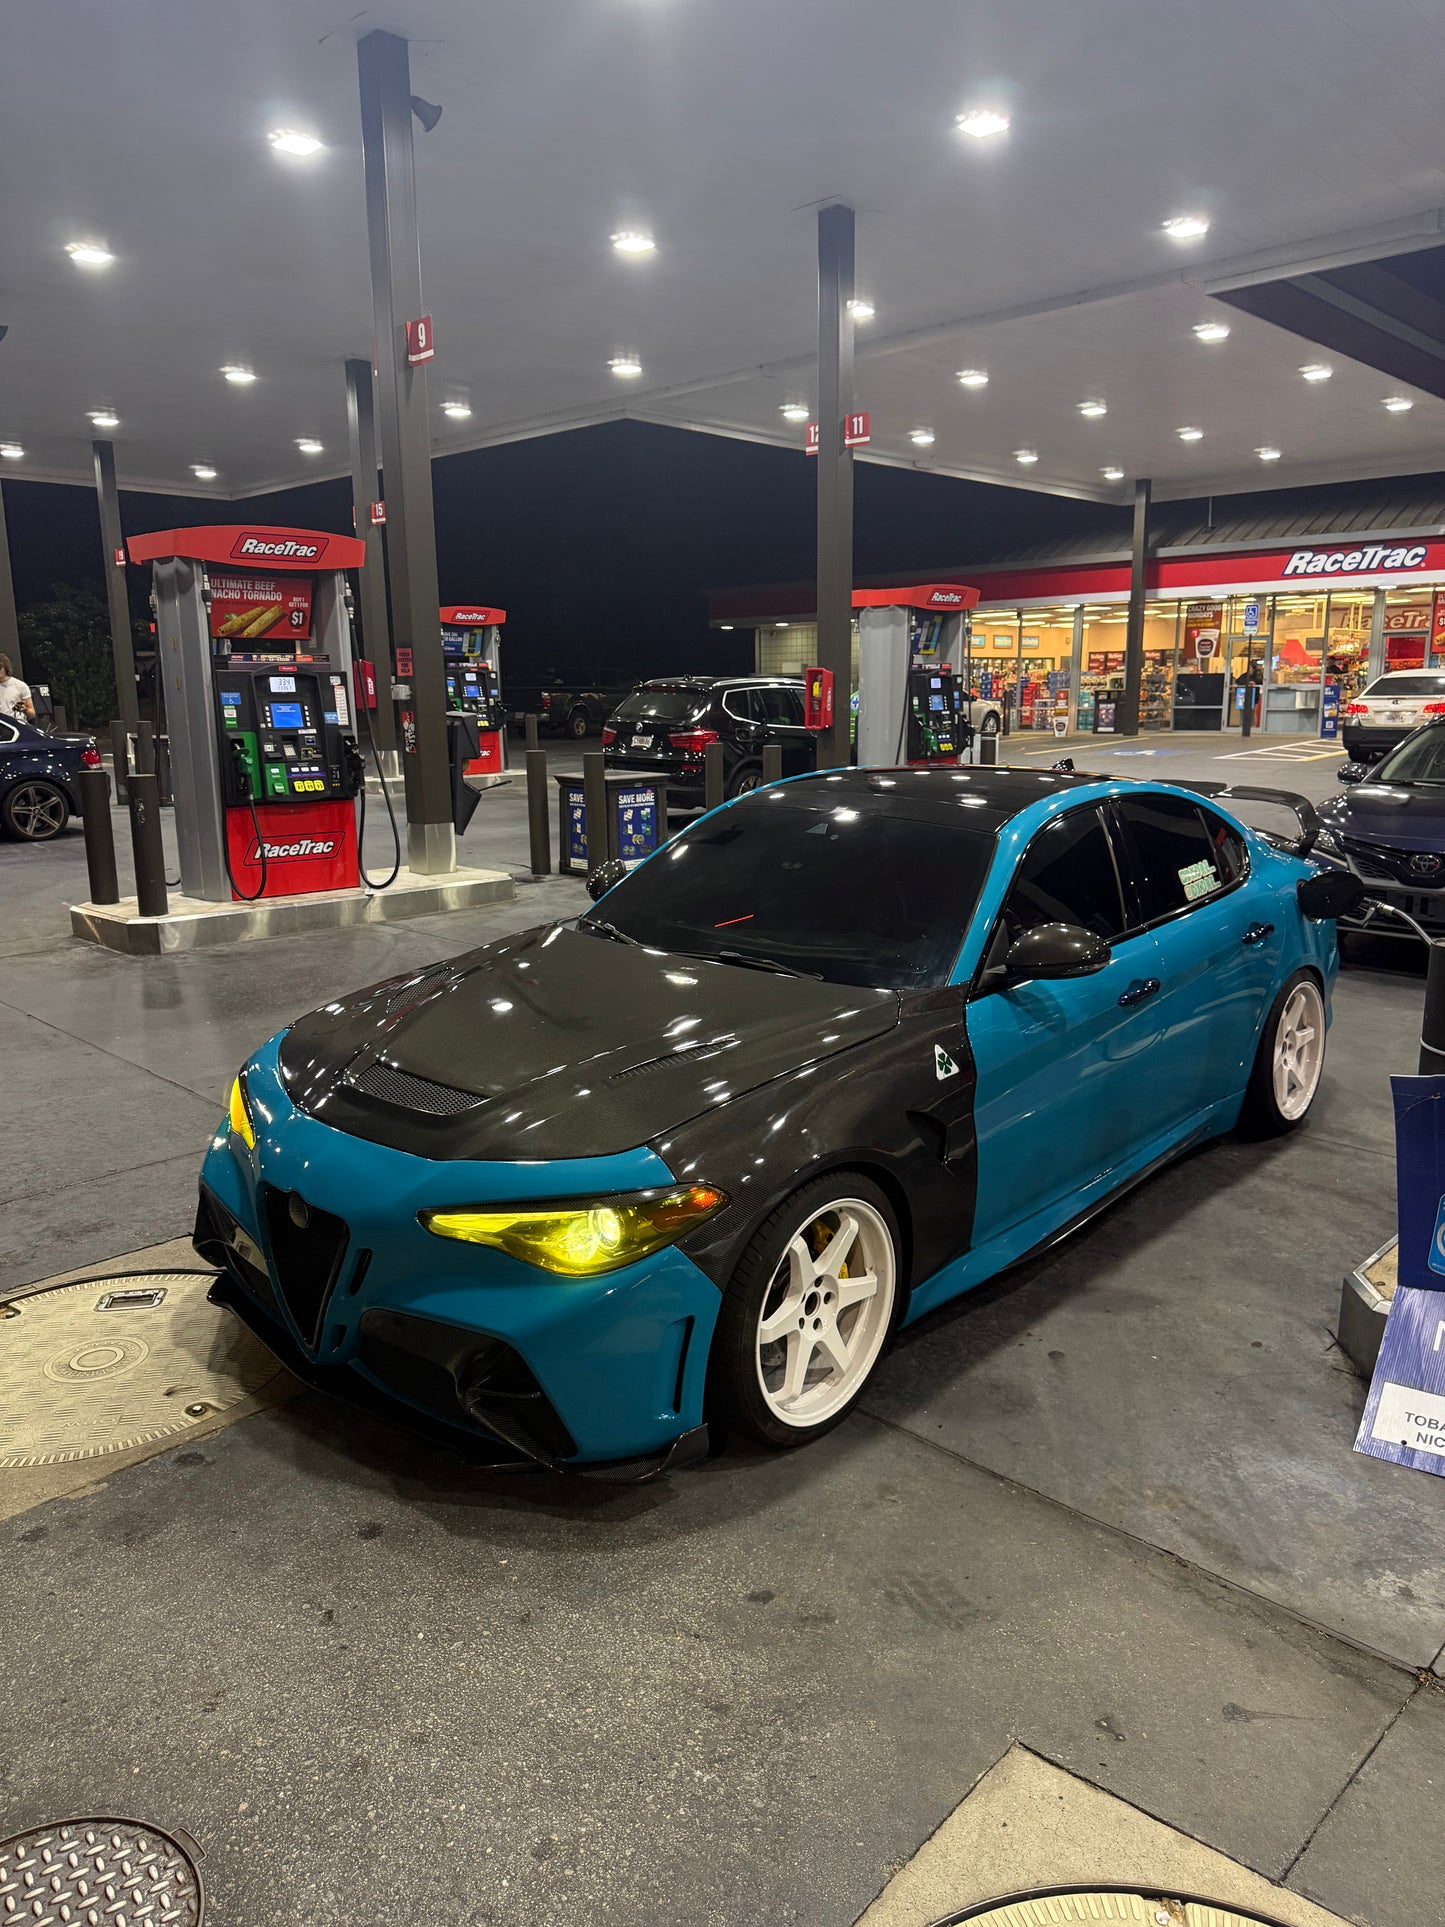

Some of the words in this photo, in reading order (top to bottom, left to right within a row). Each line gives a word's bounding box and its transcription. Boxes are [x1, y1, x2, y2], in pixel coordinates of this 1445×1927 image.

[417, 322, 426, 348] 9
[852, 415, 864, 435] 11
[375, 503, 383, 517] 15
[240, 538, 318, 557] RaceTrac
[1282, 544, 1427, 576] RaceTrac
[210, 578, 253, 590] ULTIMATE
[255, 580, 277, 591] BEEF
[211, 590, 241, 600] NACHO
[242, 590, 283, 602] TORNADO
[931, 592, 962, 603] RaceTrac
[291, 611, 304, 626] $1
[455, 612, 486, 621] RaceTrac
[568, 793, 584, 803] SAVE
[618, 794, 635, 804] SAVE
[635, 792, 655, 803] MORE
[254, 840, 334, 859] RaceTrac
